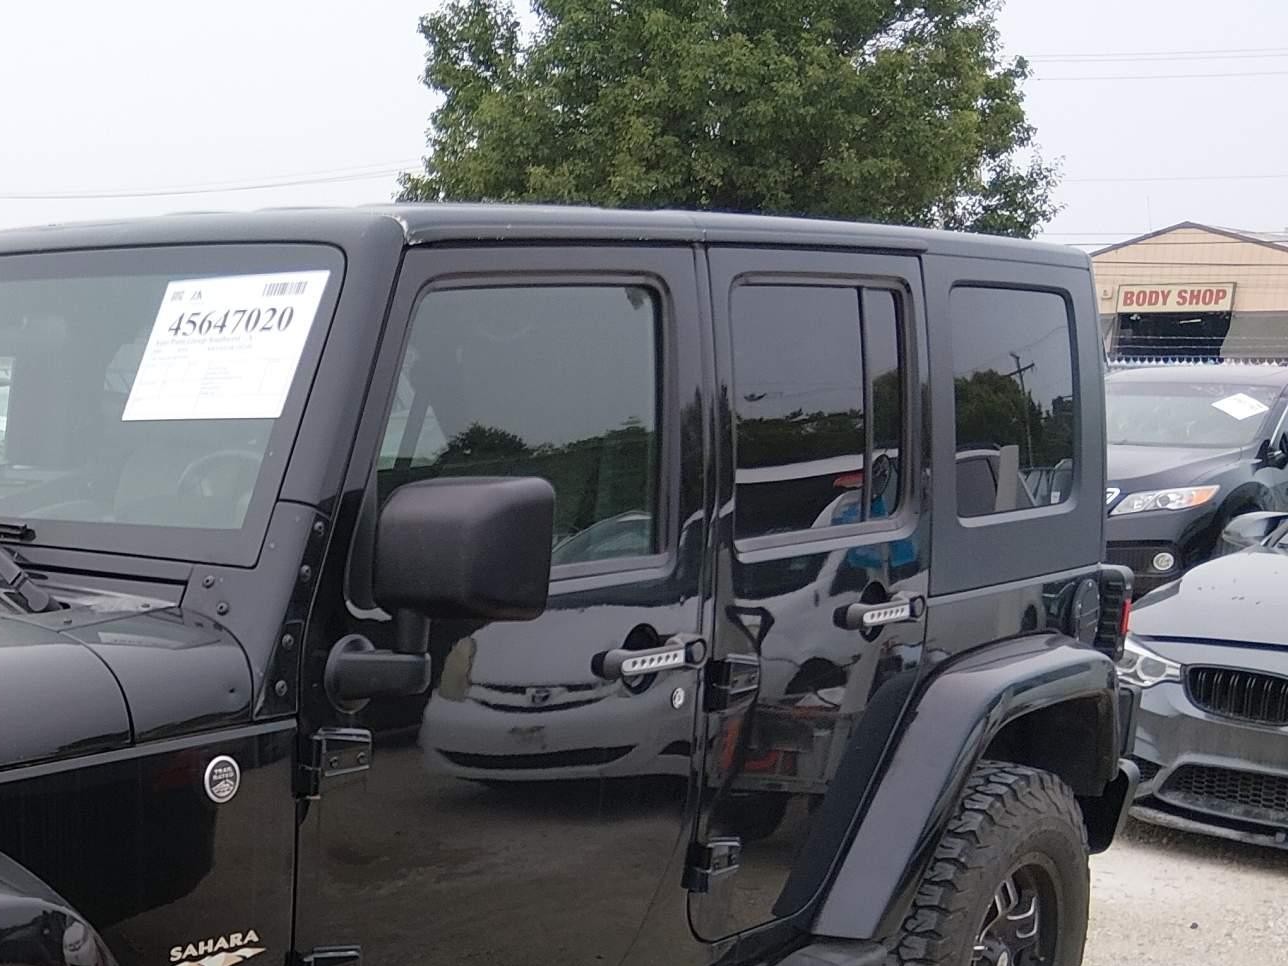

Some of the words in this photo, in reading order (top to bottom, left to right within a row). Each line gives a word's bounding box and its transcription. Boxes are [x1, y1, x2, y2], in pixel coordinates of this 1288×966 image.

[1123, 290, 1171, 307] BODY
[1176, 288, 1227, 306] SHOP
[168, 306, 294, 336] 45647020
[170, 930, 259, 961] SAHARA
